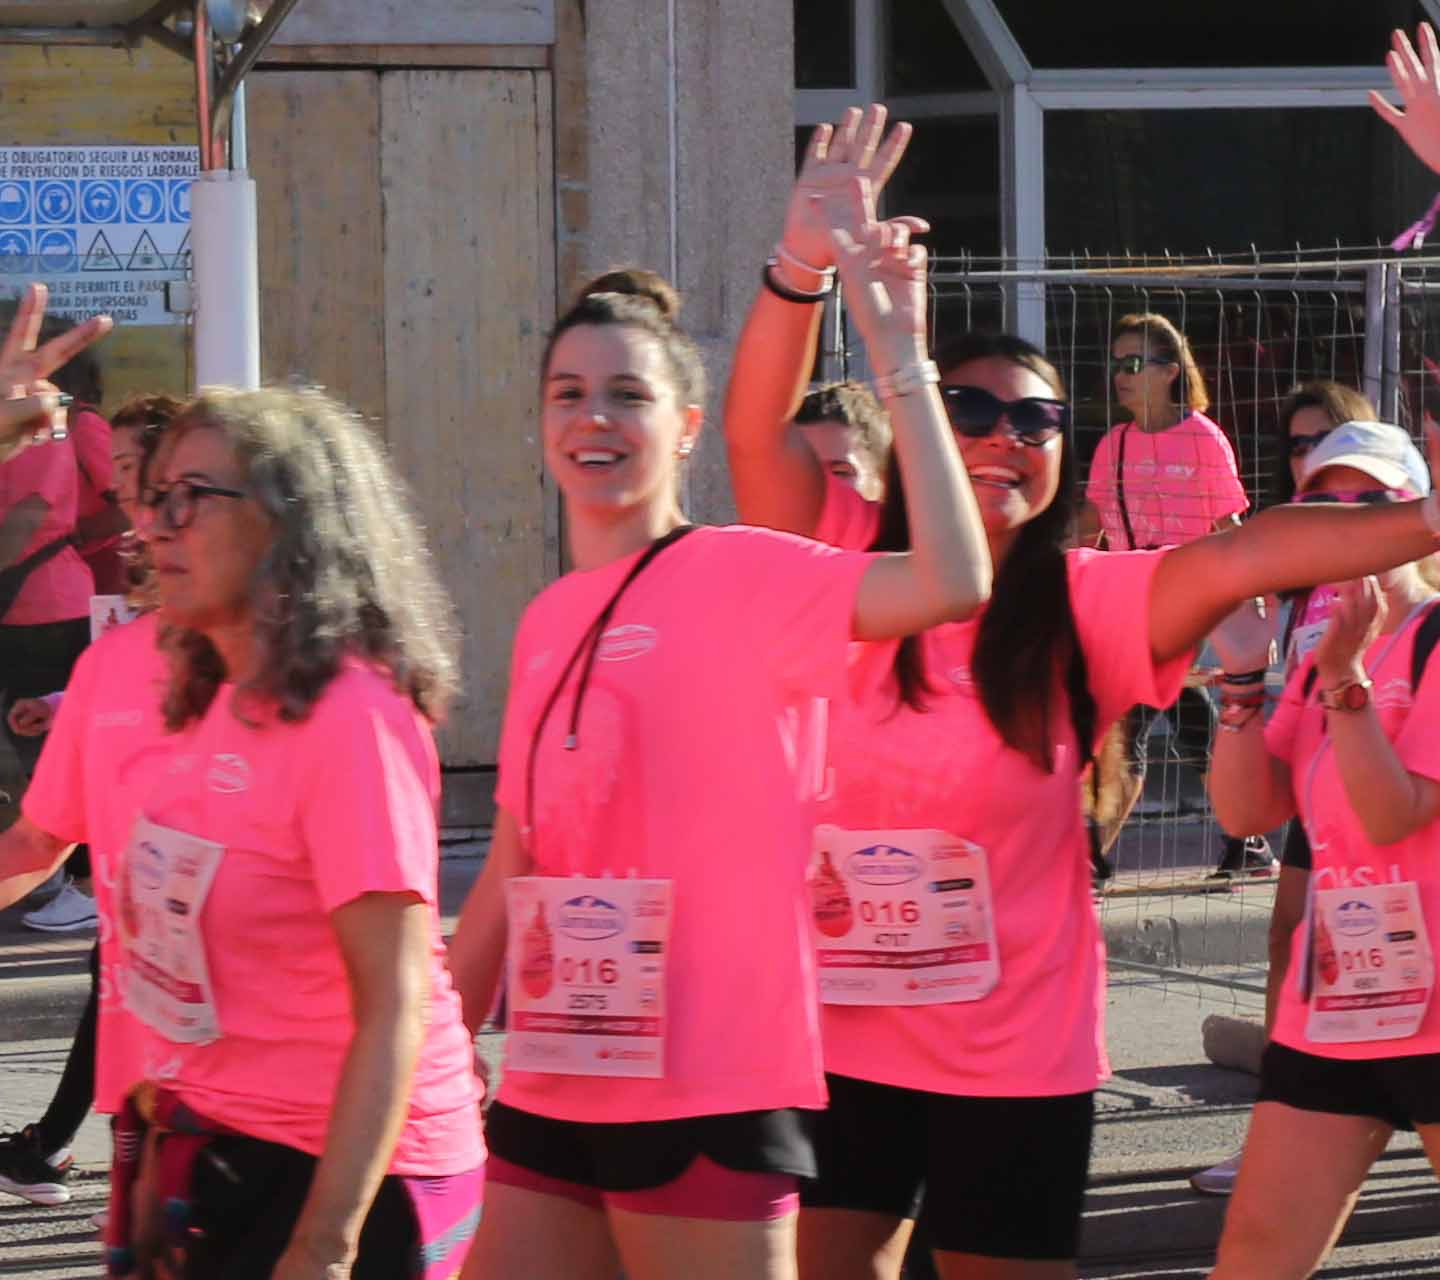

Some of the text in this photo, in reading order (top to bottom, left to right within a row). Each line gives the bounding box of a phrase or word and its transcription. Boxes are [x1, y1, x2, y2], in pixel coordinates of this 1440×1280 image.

[11, 151, 86, 164] OBLIGATORIO
[89, 151, 128, 163] SEGUIR
[131, 151, 149, 163] LAS
[152, 150, 199, 163] NORMAS
[10, 165, 78, 178] PREVENCION
[82, 165, 95, 178] DE
[99, 165, 143, 178] RIESGOS
[58, 281, 71, 293] SE
[74, 281, 121, 293] PERMITE
[123, 280, 136, 292] EL
[74, 296, 89, 308] DE
[91, 296, 149, 308] PERSONAS
[859, 900, 920, 924] 016
[1342, 948, 1385, 970] 016
[558, 957, 618, 984] 016
